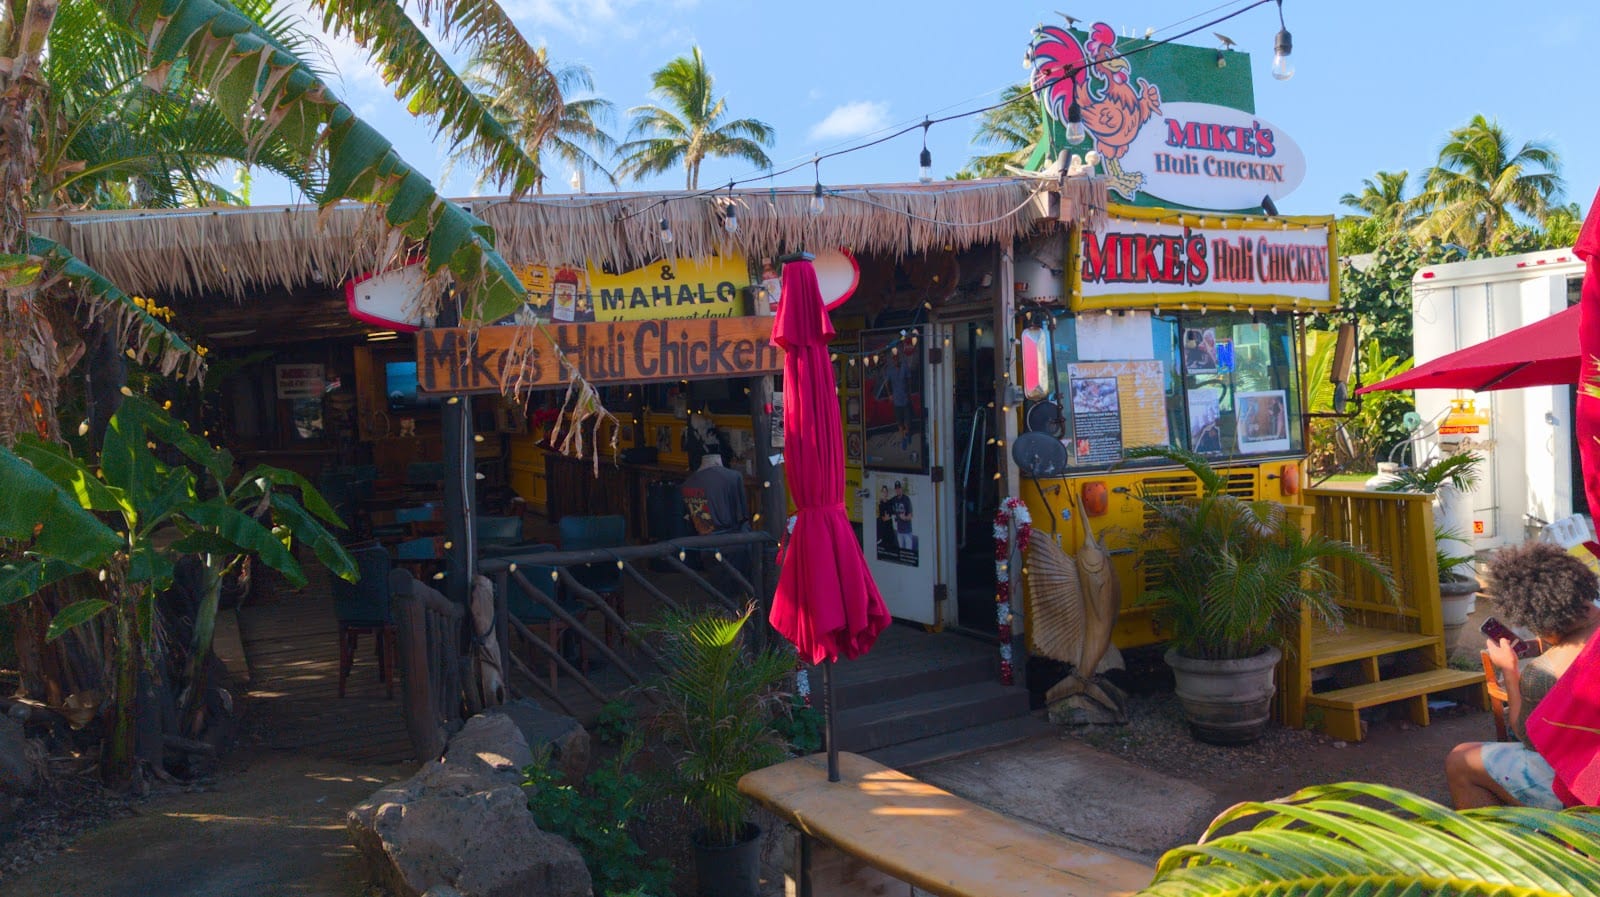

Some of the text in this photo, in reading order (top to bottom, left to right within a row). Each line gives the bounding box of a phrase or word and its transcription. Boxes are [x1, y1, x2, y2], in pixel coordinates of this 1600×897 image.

[1164, 118, 1276, 158] MIKE'S
[661, 265, 675, 281] &
[1081, 226, 1208, 287] MIKE'S
[600, 280, 737, 311] MAHALO
[558, 324, 624, 381] Huli
[634, 320, 777, 376] Chicken
